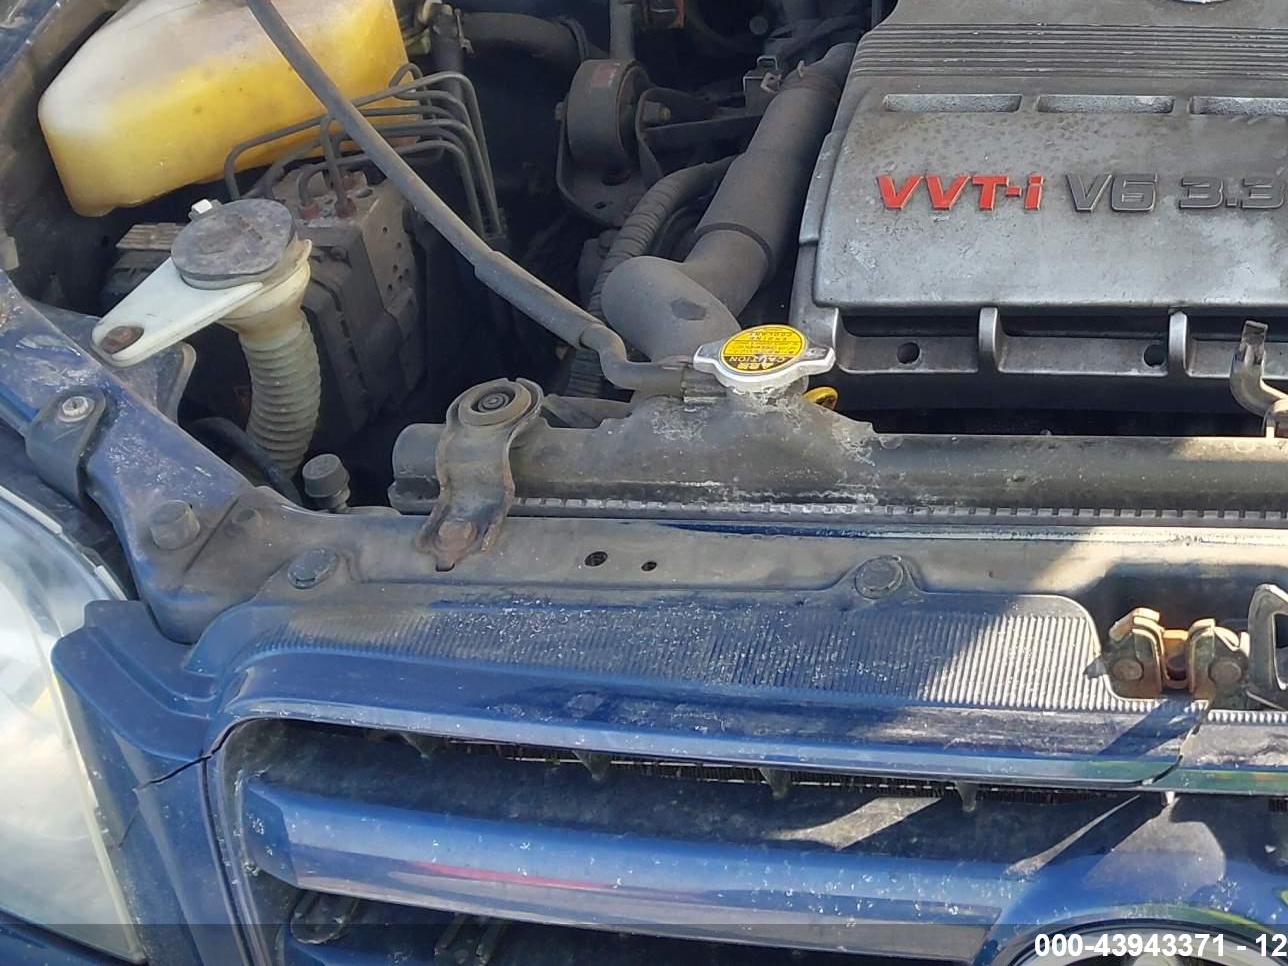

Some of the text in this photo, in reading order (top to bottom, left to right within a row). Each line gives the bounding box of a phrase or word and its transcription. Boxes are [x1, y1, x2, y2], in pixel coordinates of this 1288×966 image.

[876, 172, 1288, 213] VVT-i V6 3.3
[728, 355, 786, 363] CAUTION
